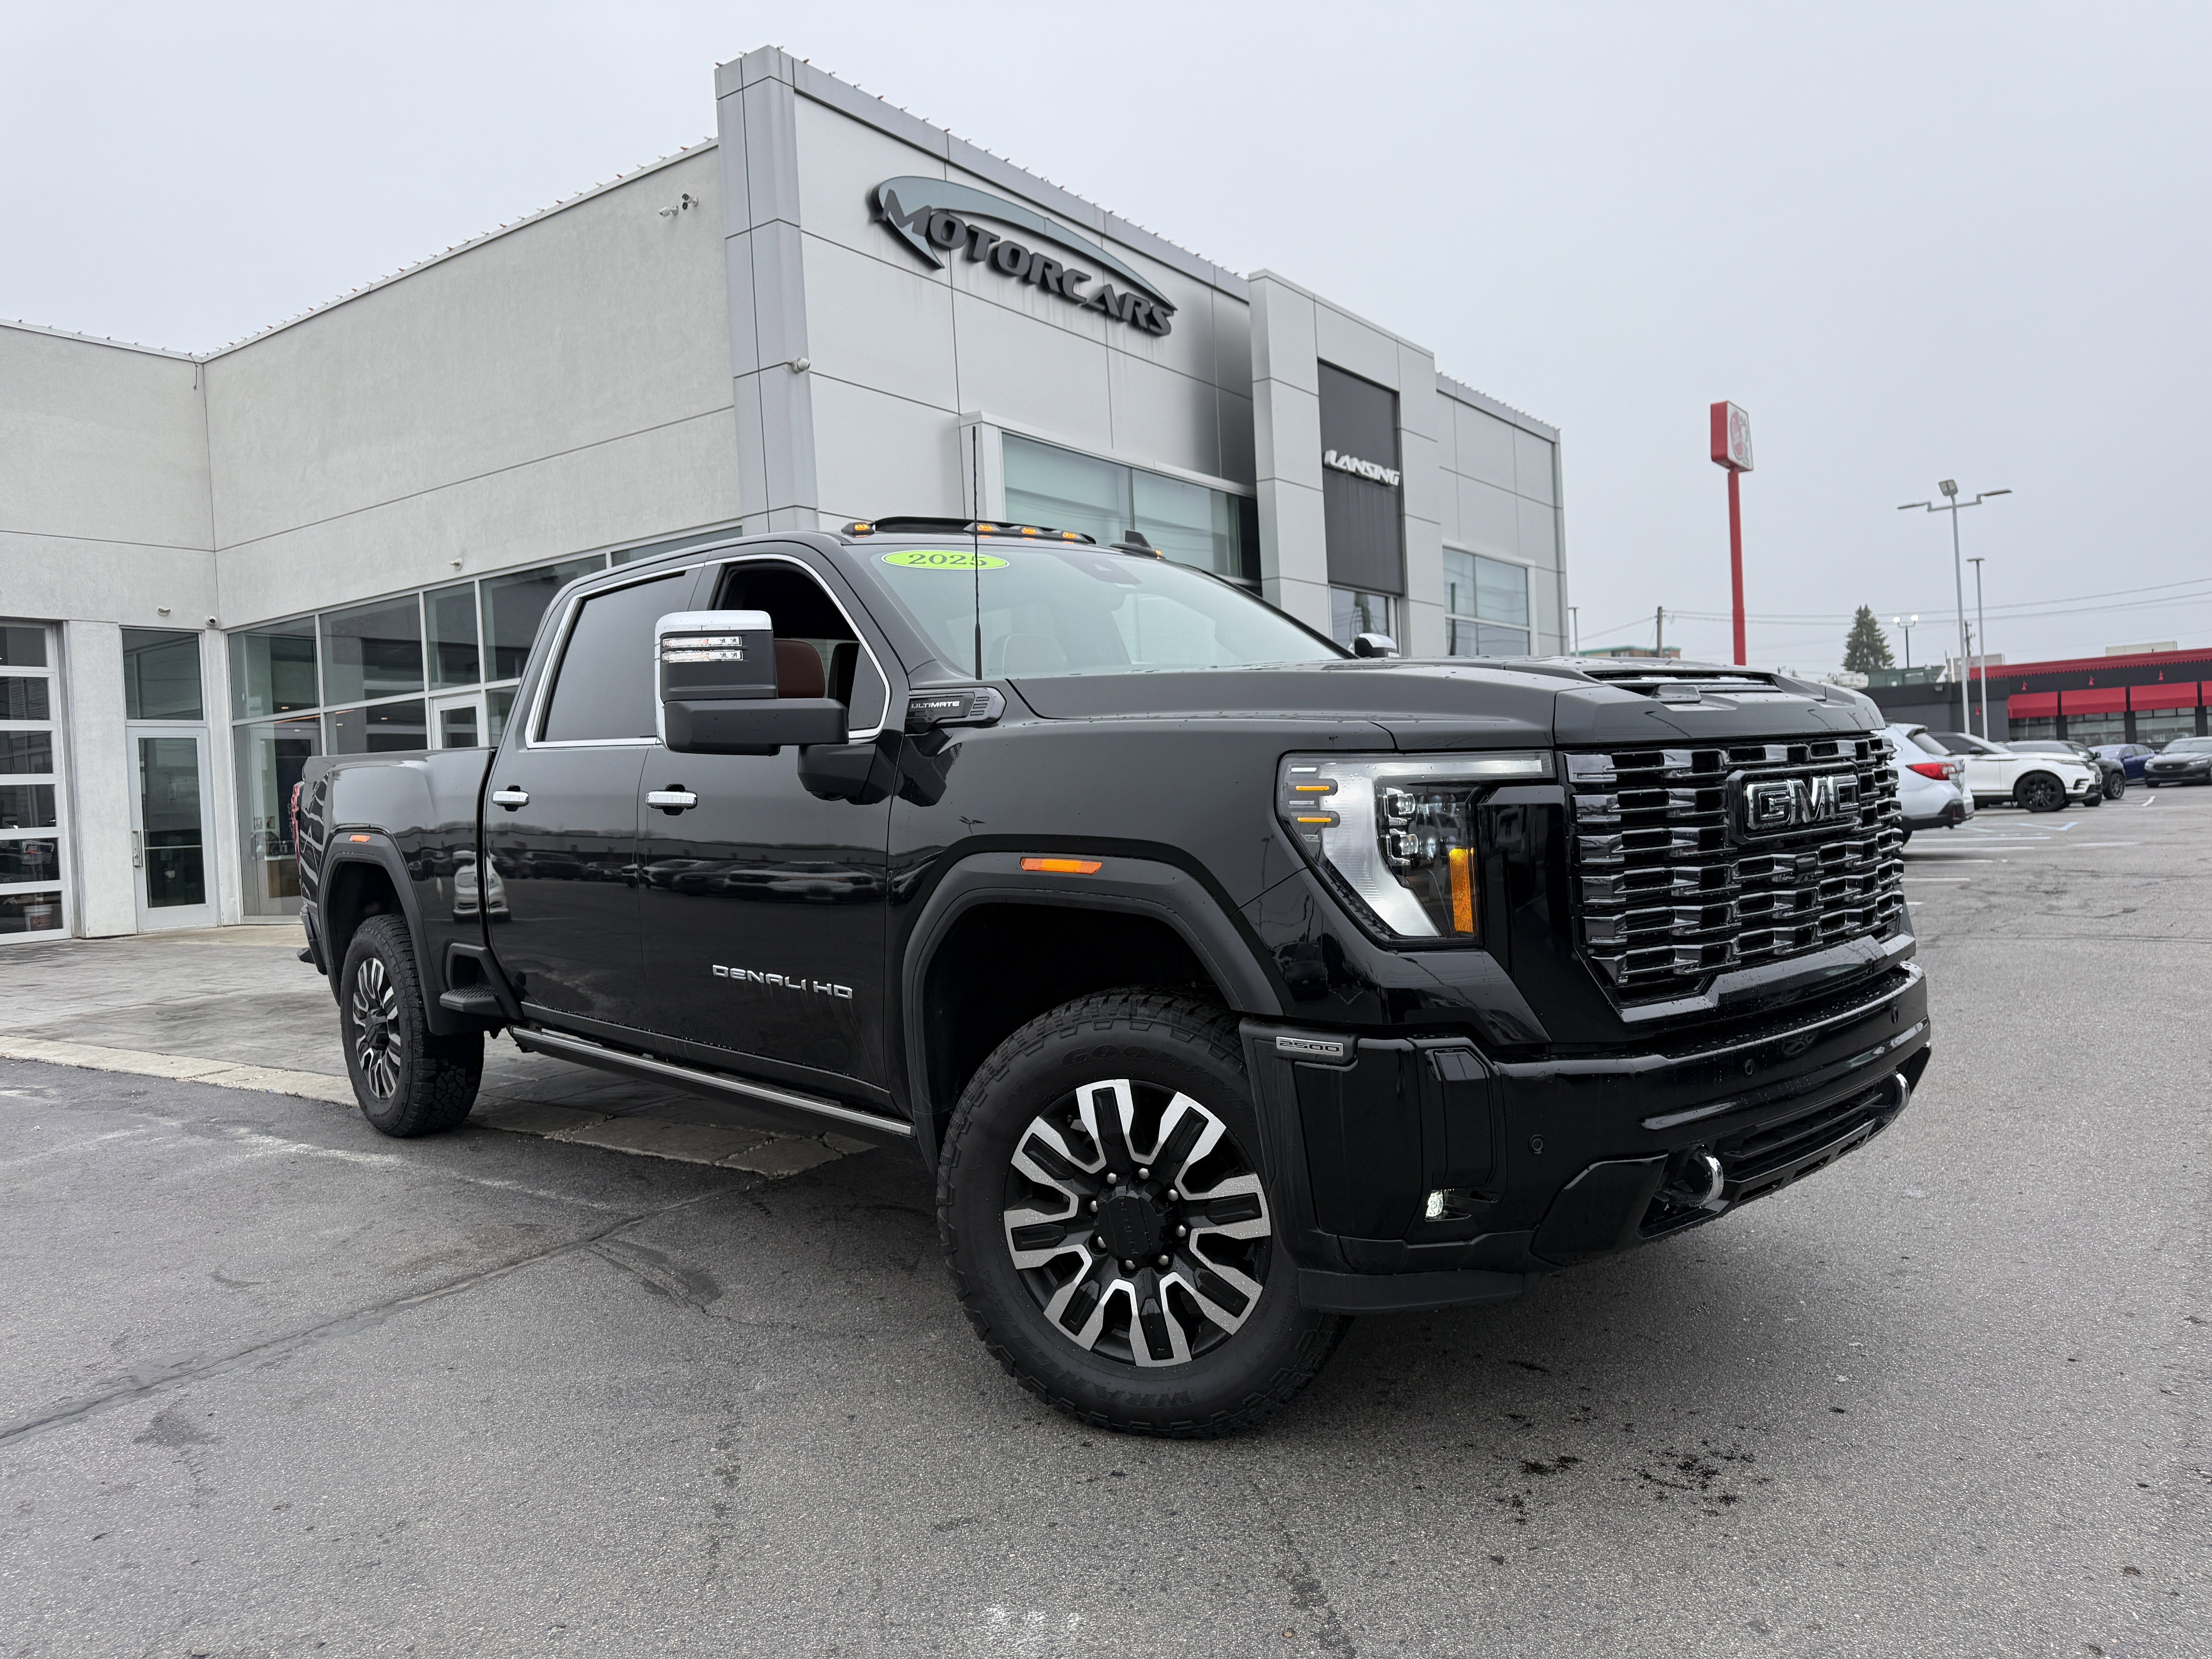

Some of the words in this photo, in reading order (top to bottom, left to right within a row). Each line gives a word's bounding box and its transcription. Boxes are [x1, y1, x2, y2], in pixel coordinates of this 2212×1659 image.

[878, 189, 1172, 336] MOTORCARS
[1324, 449, 1400, 486] LANSING
[908, 554, 987, 566] 2025
[911, 701, 960, 709] ULTIMATE
[1744, 774, 1859, 830] GMC
[712, 964, 807, 991] DENALI
[813, 981, 853, 999] HD
[1279, 1041, 1340, 1052] 2500
[977, 1267, 1194, 1408] WRANGLER
